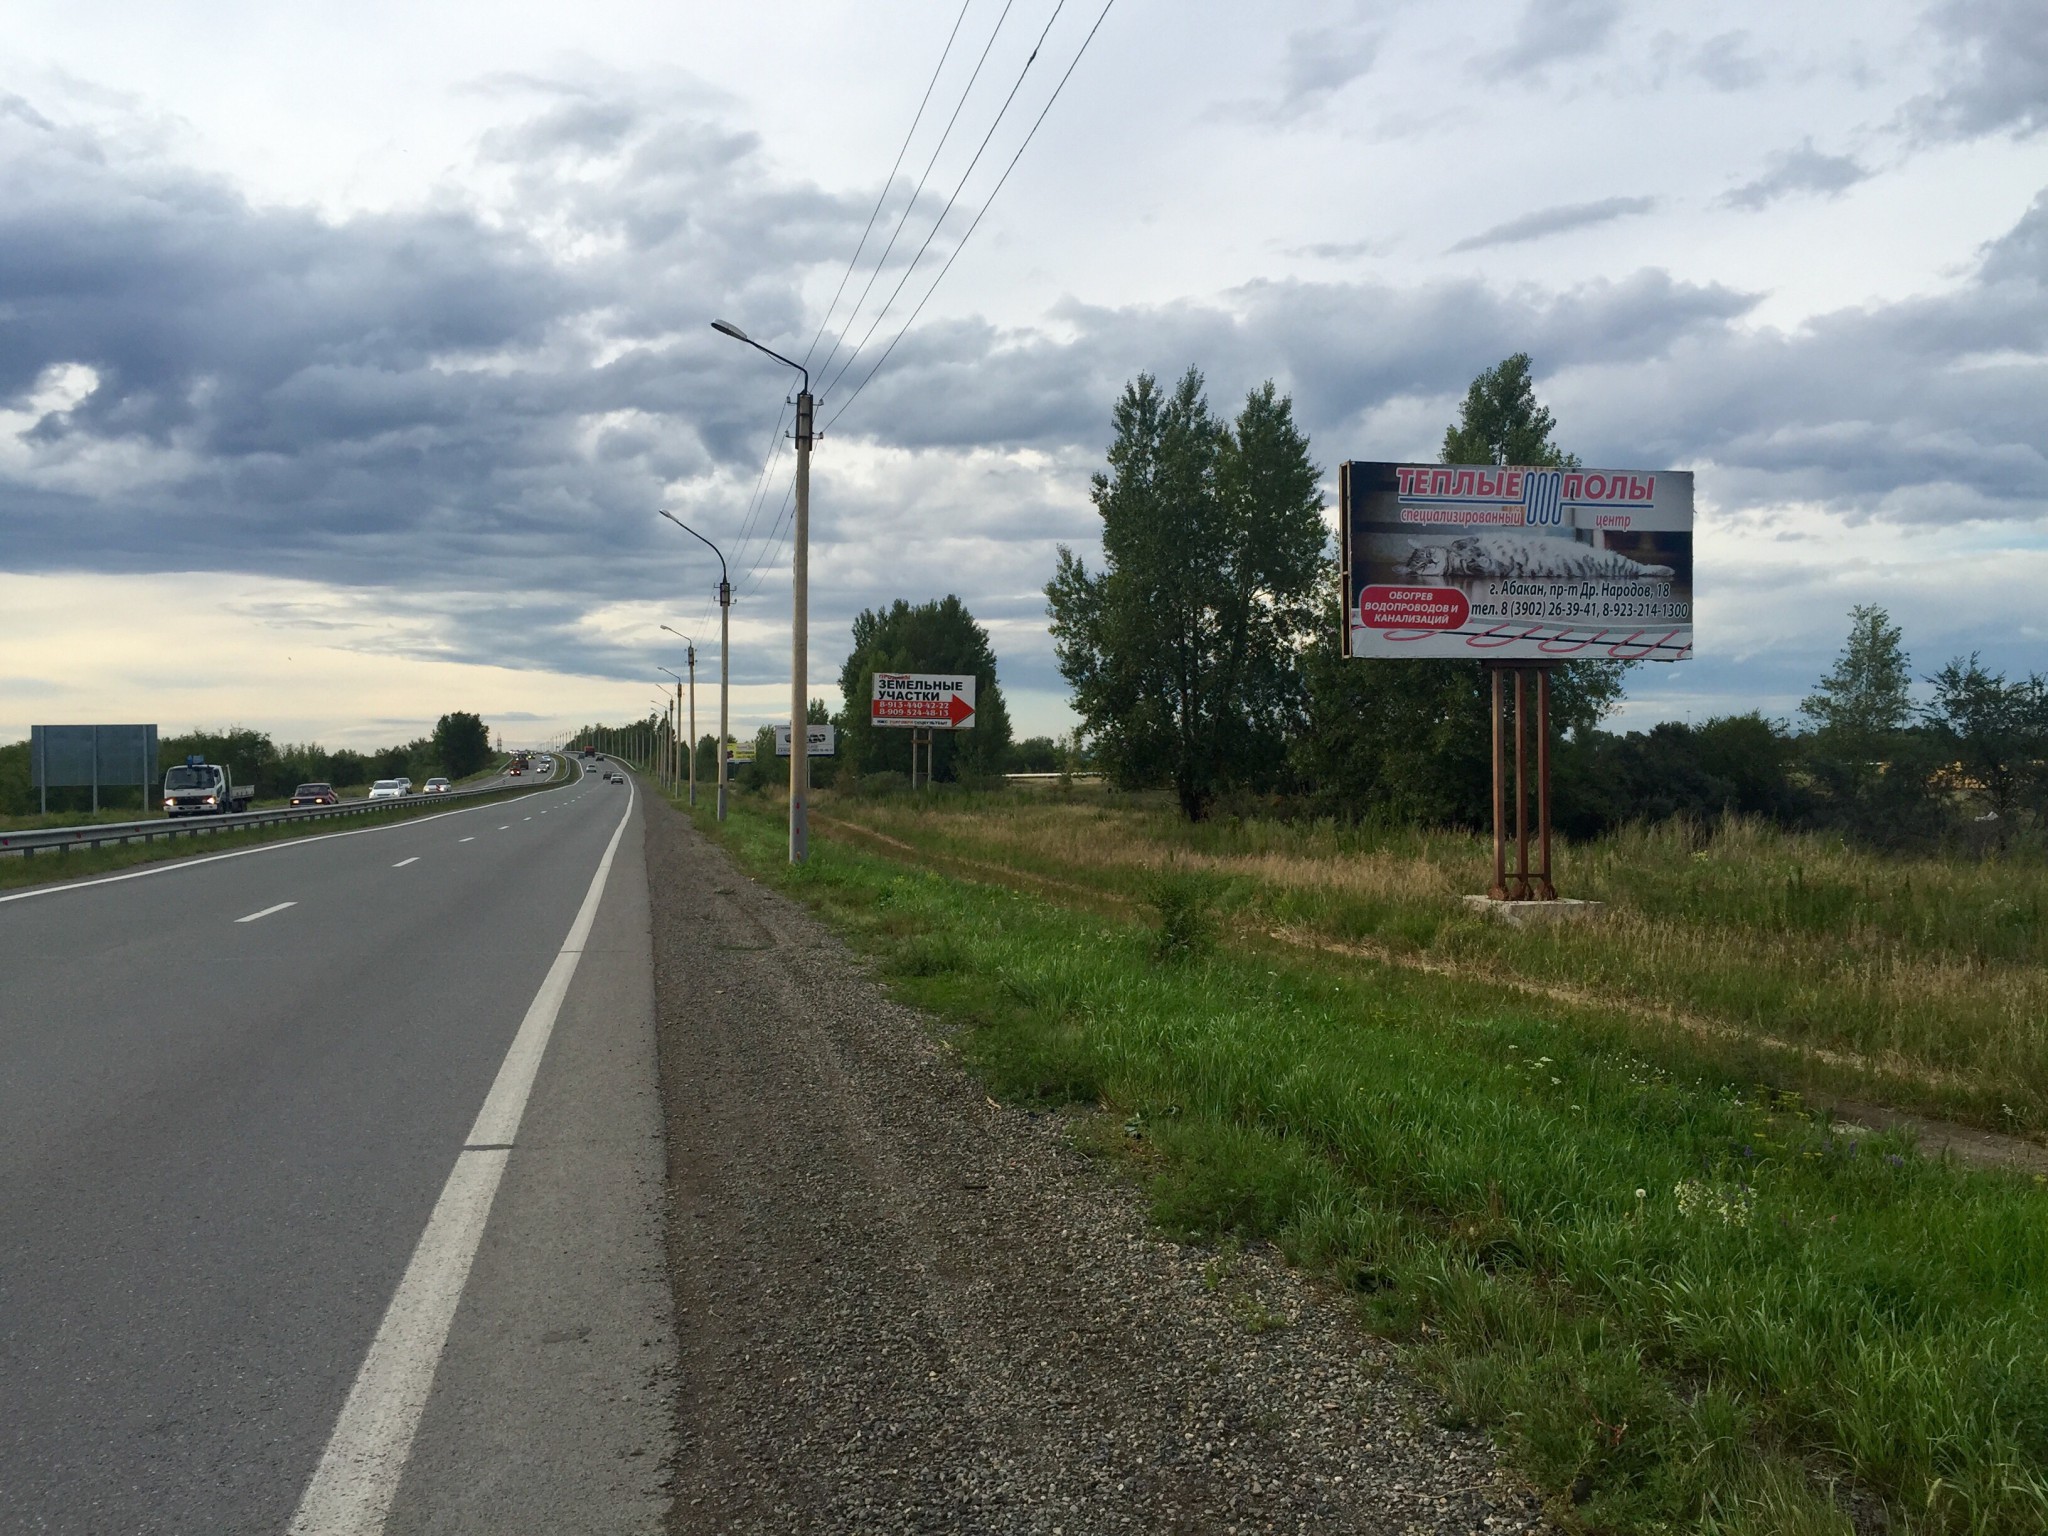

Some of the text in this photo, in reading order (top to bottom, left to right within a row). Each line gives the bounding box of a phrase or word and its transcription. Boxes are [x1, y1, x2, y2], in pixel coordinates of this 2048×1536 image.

[1397, 468, 1655, 500] ТЕПЛЫЕ ПОЛЫ
[1401, 508, 1631, 531] специализированный центр
[1389, 591, 1433, 601] ОБОГРЕВ
[1489, 581, 1670, 600] г. Абакан, пр-т Др. Народов, 18
[1365, 602, 1458, 613] ВОДОПРОВОДОВ И
[1471, 601, 1688, 618] тел. 8 (3902) 26-39-41, 8-923-214-1300
[1374, 614, 1449, 625] КАНАЛИЗАЦИЙ
[878, 680, 963, 691] ЗЕМЕЛЬНЫЕ
[878, 691, 940, 701] УЧАСТКИ
